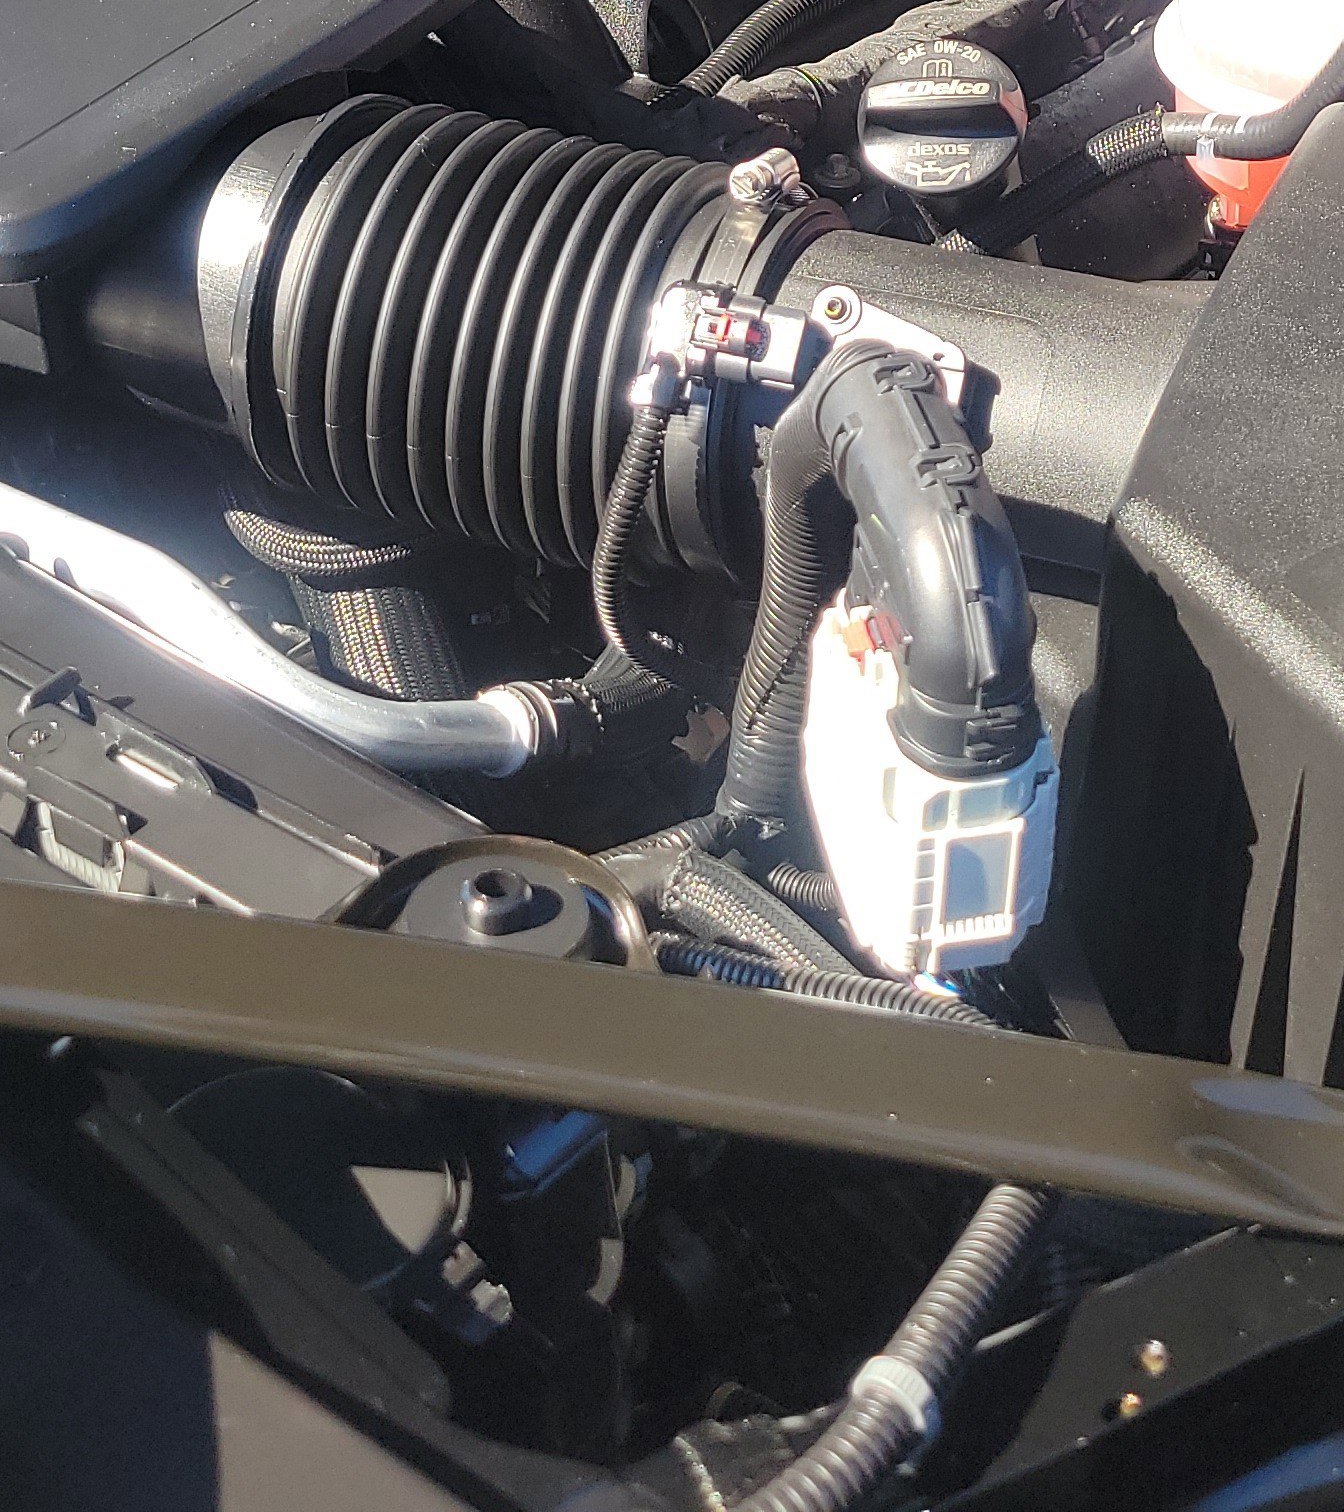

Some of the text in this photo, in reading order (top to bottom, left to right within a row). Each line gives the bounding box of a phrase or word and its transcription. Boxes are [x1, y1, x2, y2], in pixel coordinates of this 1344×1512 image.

[897, 40, 981, 66] SAE 0W-20
[907, 142, 972, 157] dexos
